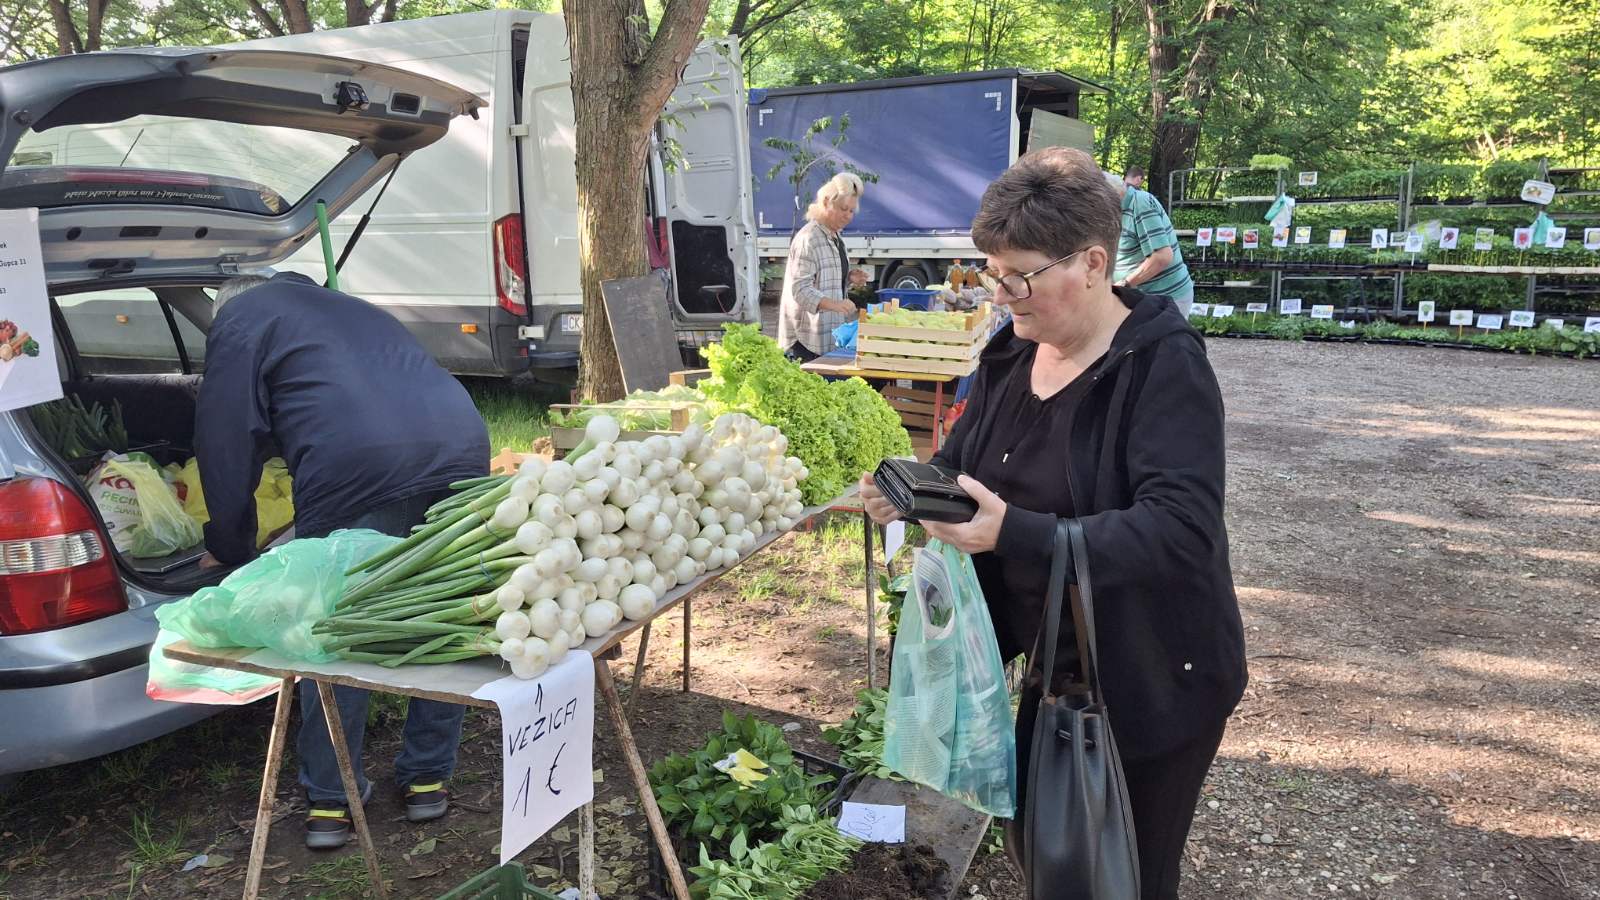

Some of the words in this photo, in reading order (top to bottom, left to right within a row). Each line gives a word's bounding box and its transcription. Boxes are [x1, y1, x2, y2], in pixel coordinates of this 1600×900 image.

[508, 697, 577, 757] VEZICA
[534, 682, 544, 713] 1
[511, 766, 532, 818] 1
[545, 741, 567, 796] €
